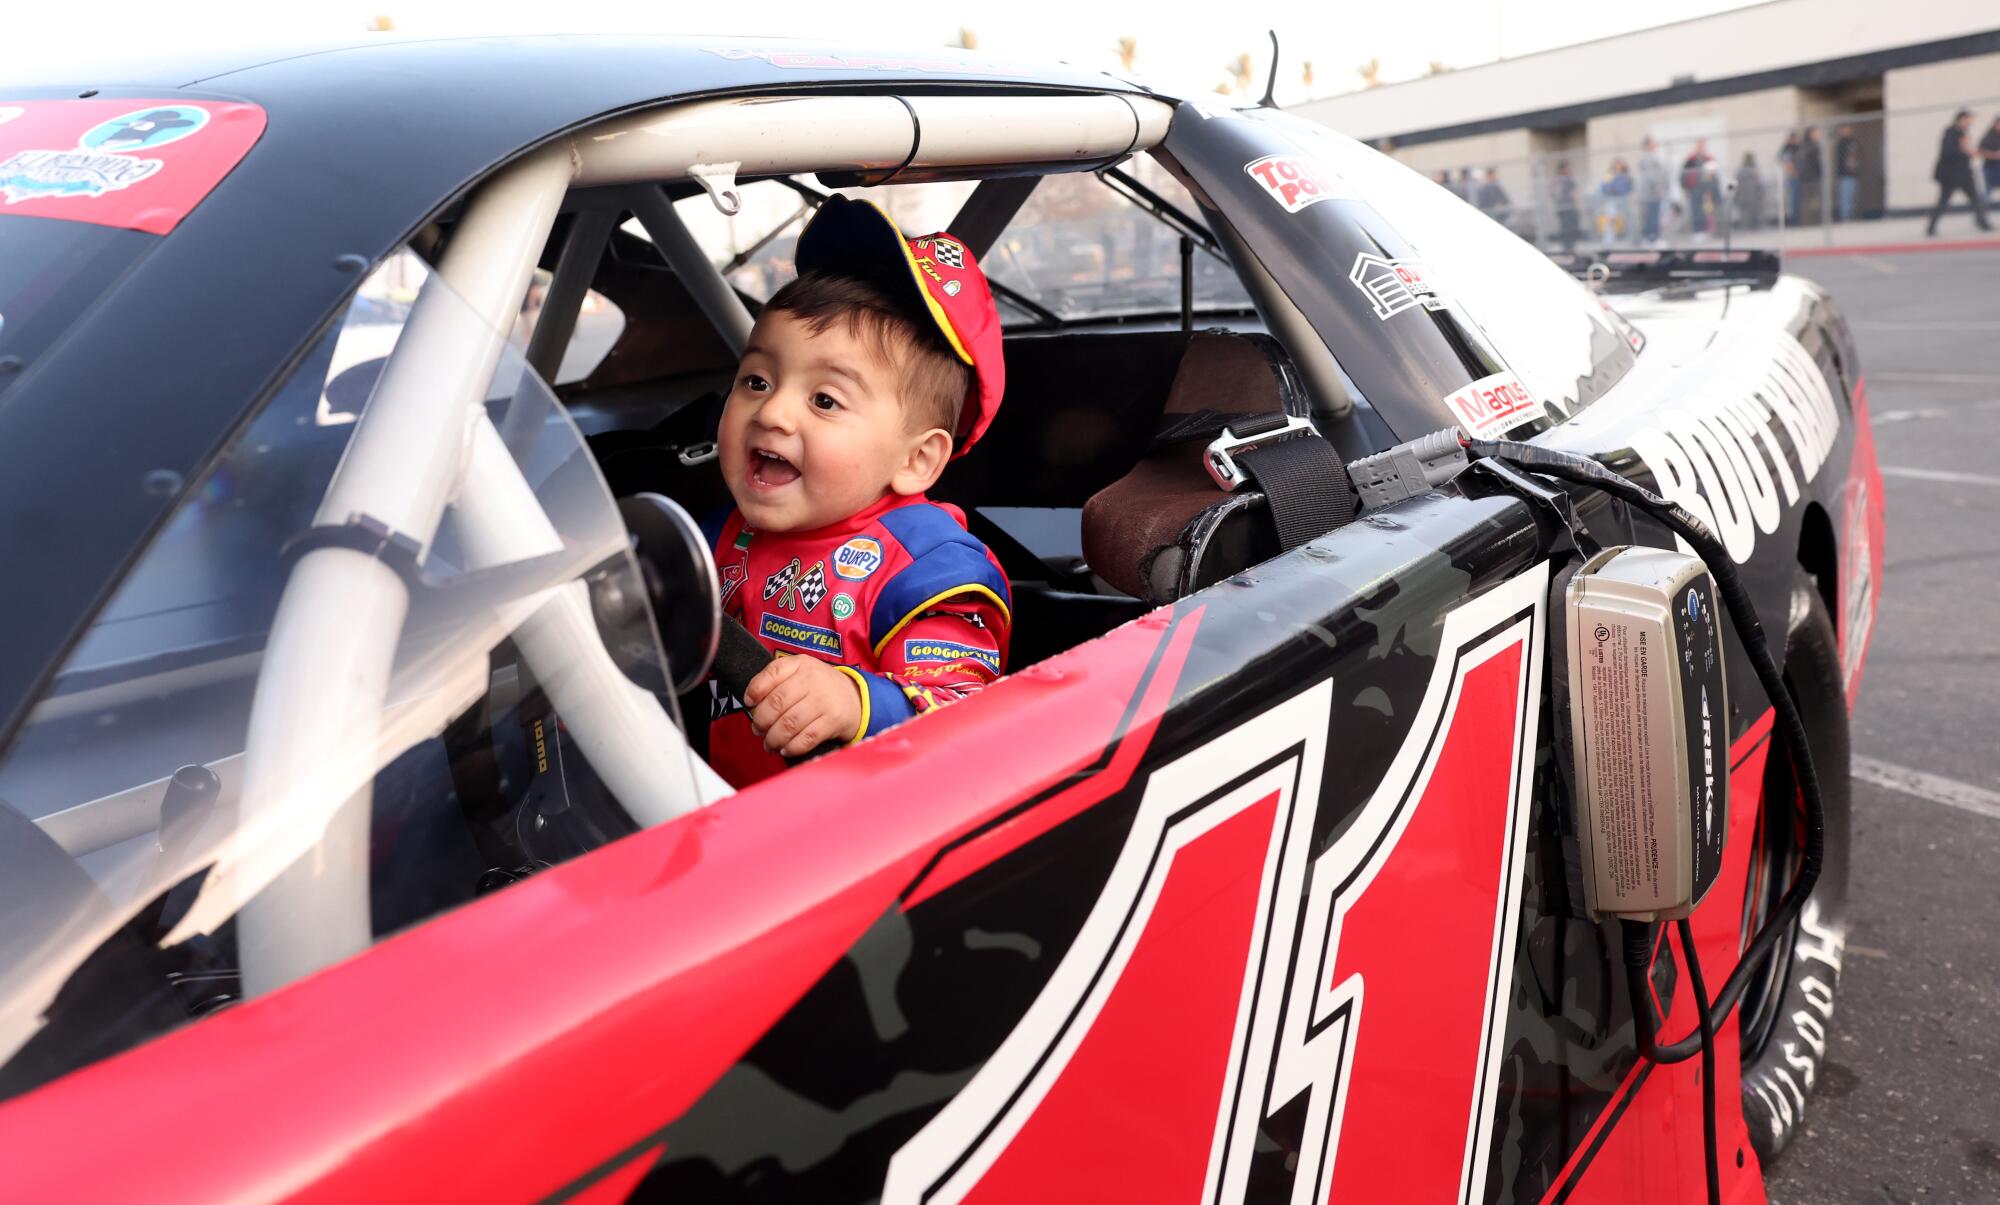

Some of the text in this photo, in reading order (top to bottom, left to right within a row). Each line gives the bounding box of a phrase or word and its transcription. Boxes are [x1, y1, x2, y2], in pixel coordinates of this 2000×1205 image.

[1455, 381, 1530, 424] Magnus
[839, 546, 879, 572] BURPZ
[834, 599, 850, 614] GO
[1640, 647, 1647, 656] EN
[879, 559, 1550, 1205] 11
